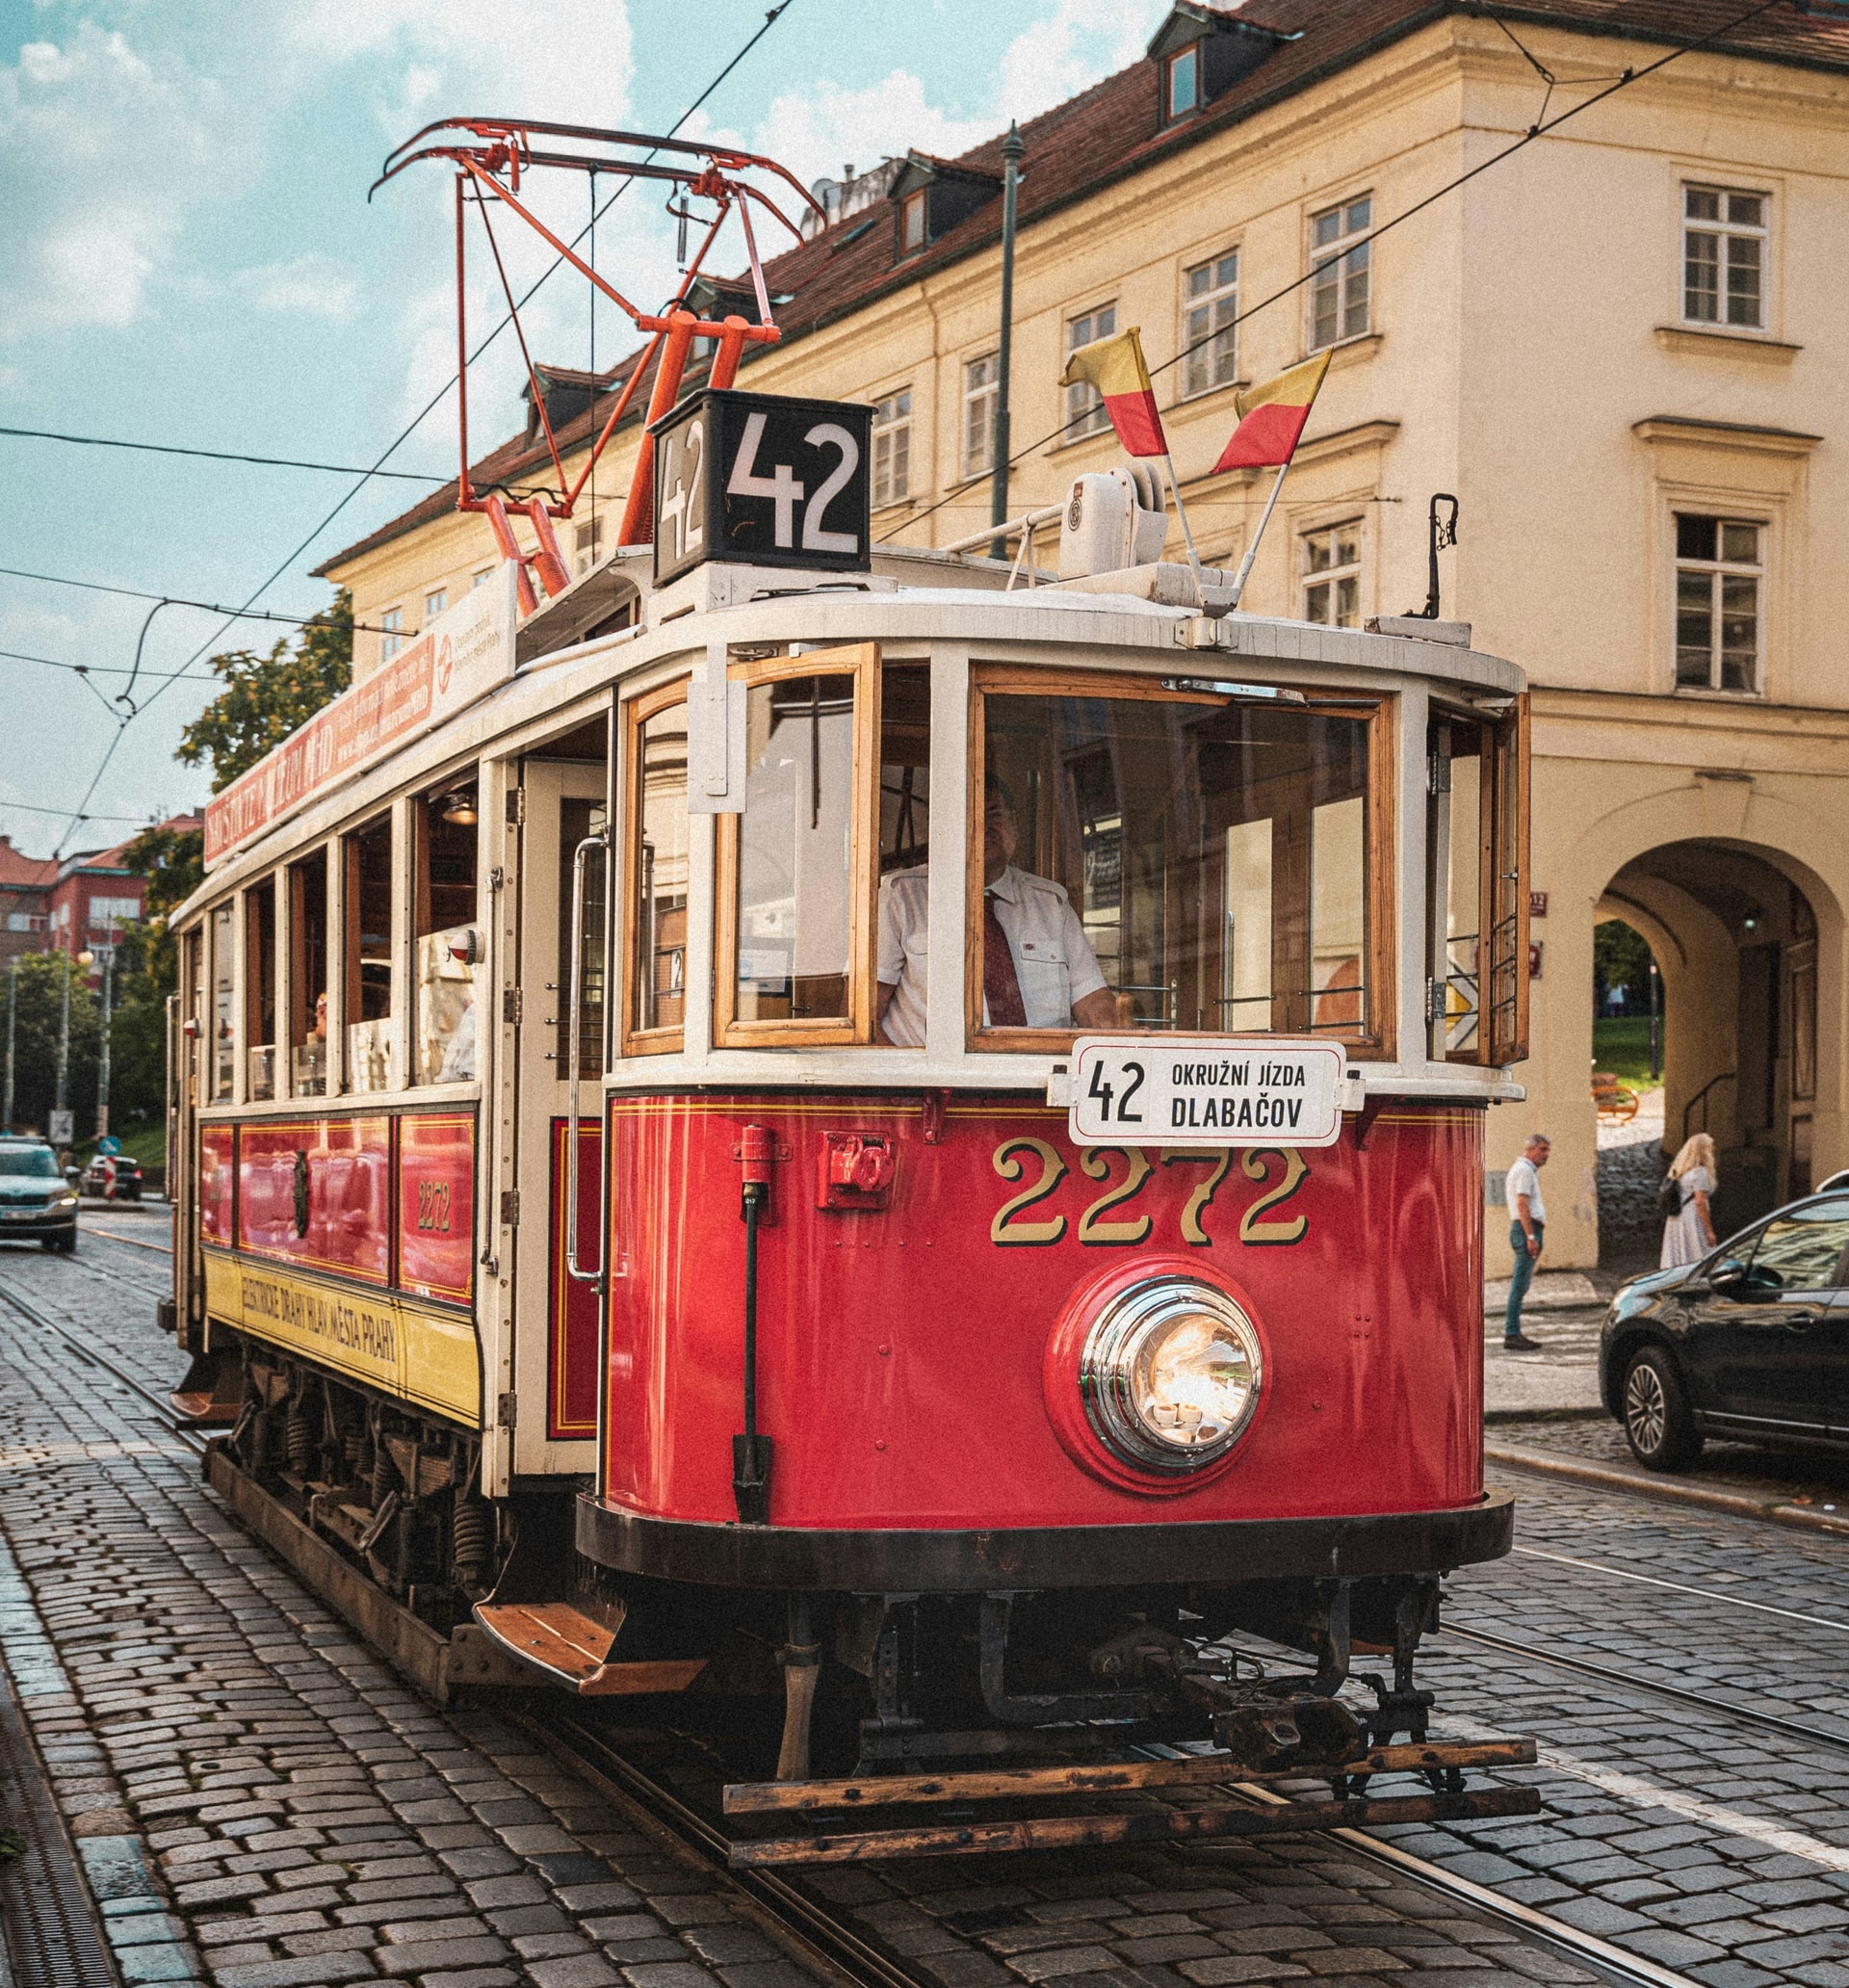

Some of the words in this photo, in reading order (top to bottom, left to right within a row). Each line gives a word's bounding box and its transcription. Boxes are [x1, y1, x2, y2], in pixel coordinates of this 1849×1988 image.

[660, 420, 703, 560] 42
[726, 412, 859, 554] 42
[1088, 1059, 1145, 1123] 42
[1171, 1060, 1250, 1086] OKRUŽNÍ
[1257, 1061, 1306, 1087] JÍZDA
[1171, 1092, 1303, 1128] DLABAČOV
[418, 1181, 450, 1232] 2272
[990, 1137, 1311, 1247] 2272
[327, 1299, 360, 1350] MĚSTA
[361, 1313, 396, 1362] PRAHY
